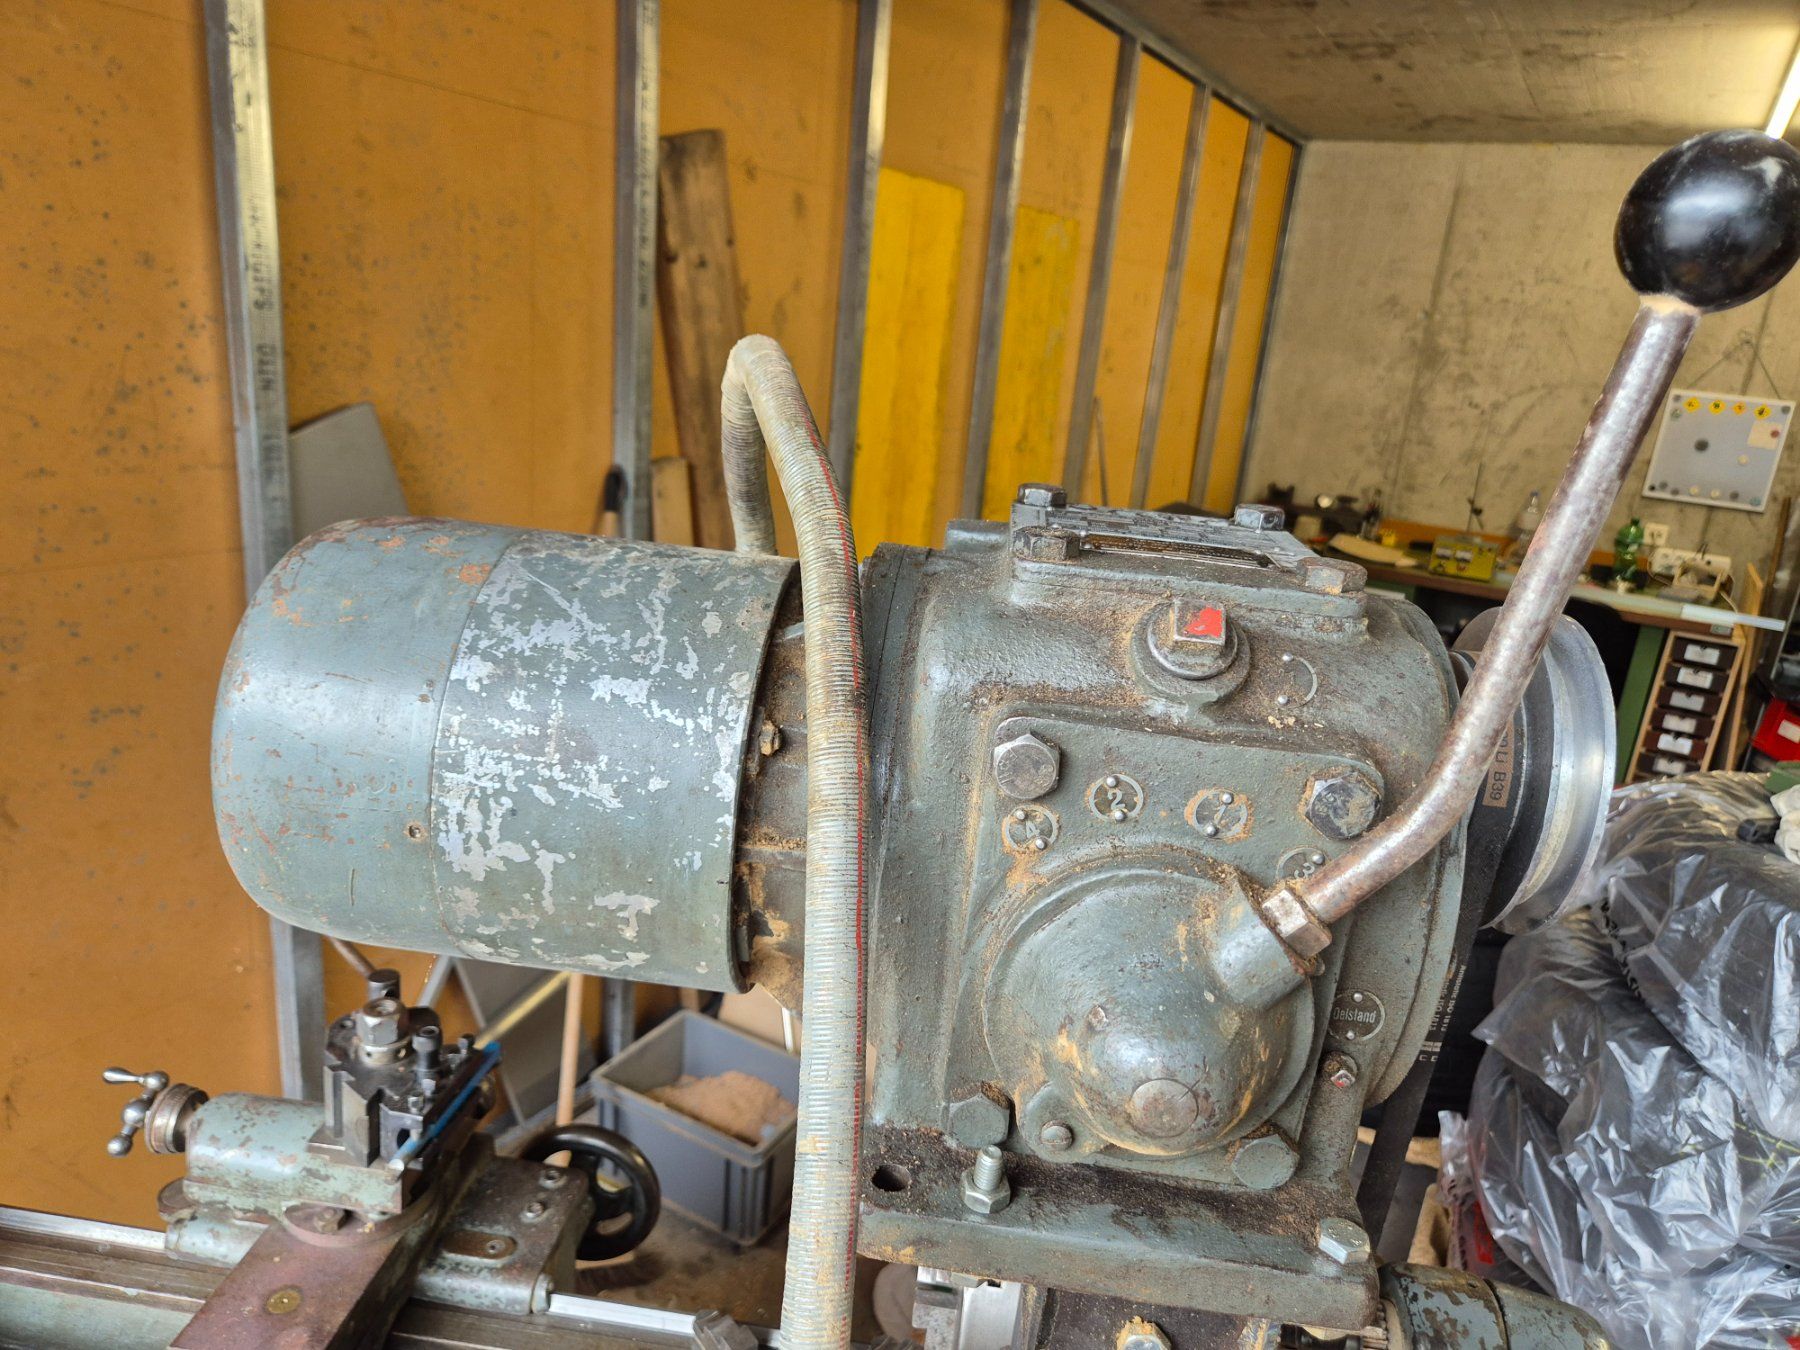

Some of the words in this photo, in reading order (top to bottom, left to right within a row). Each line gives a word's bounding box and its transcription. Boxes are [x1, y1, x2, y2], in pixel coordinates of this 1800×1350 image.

[1489, 771, 1506, 800] B39
[1107, 788, 1126, 810] 2
[1025, 819, 1041, 840] 4
[1293, 862, 1315, 881] 3
[1333, 1006, 1377, 1023] Oelstand
